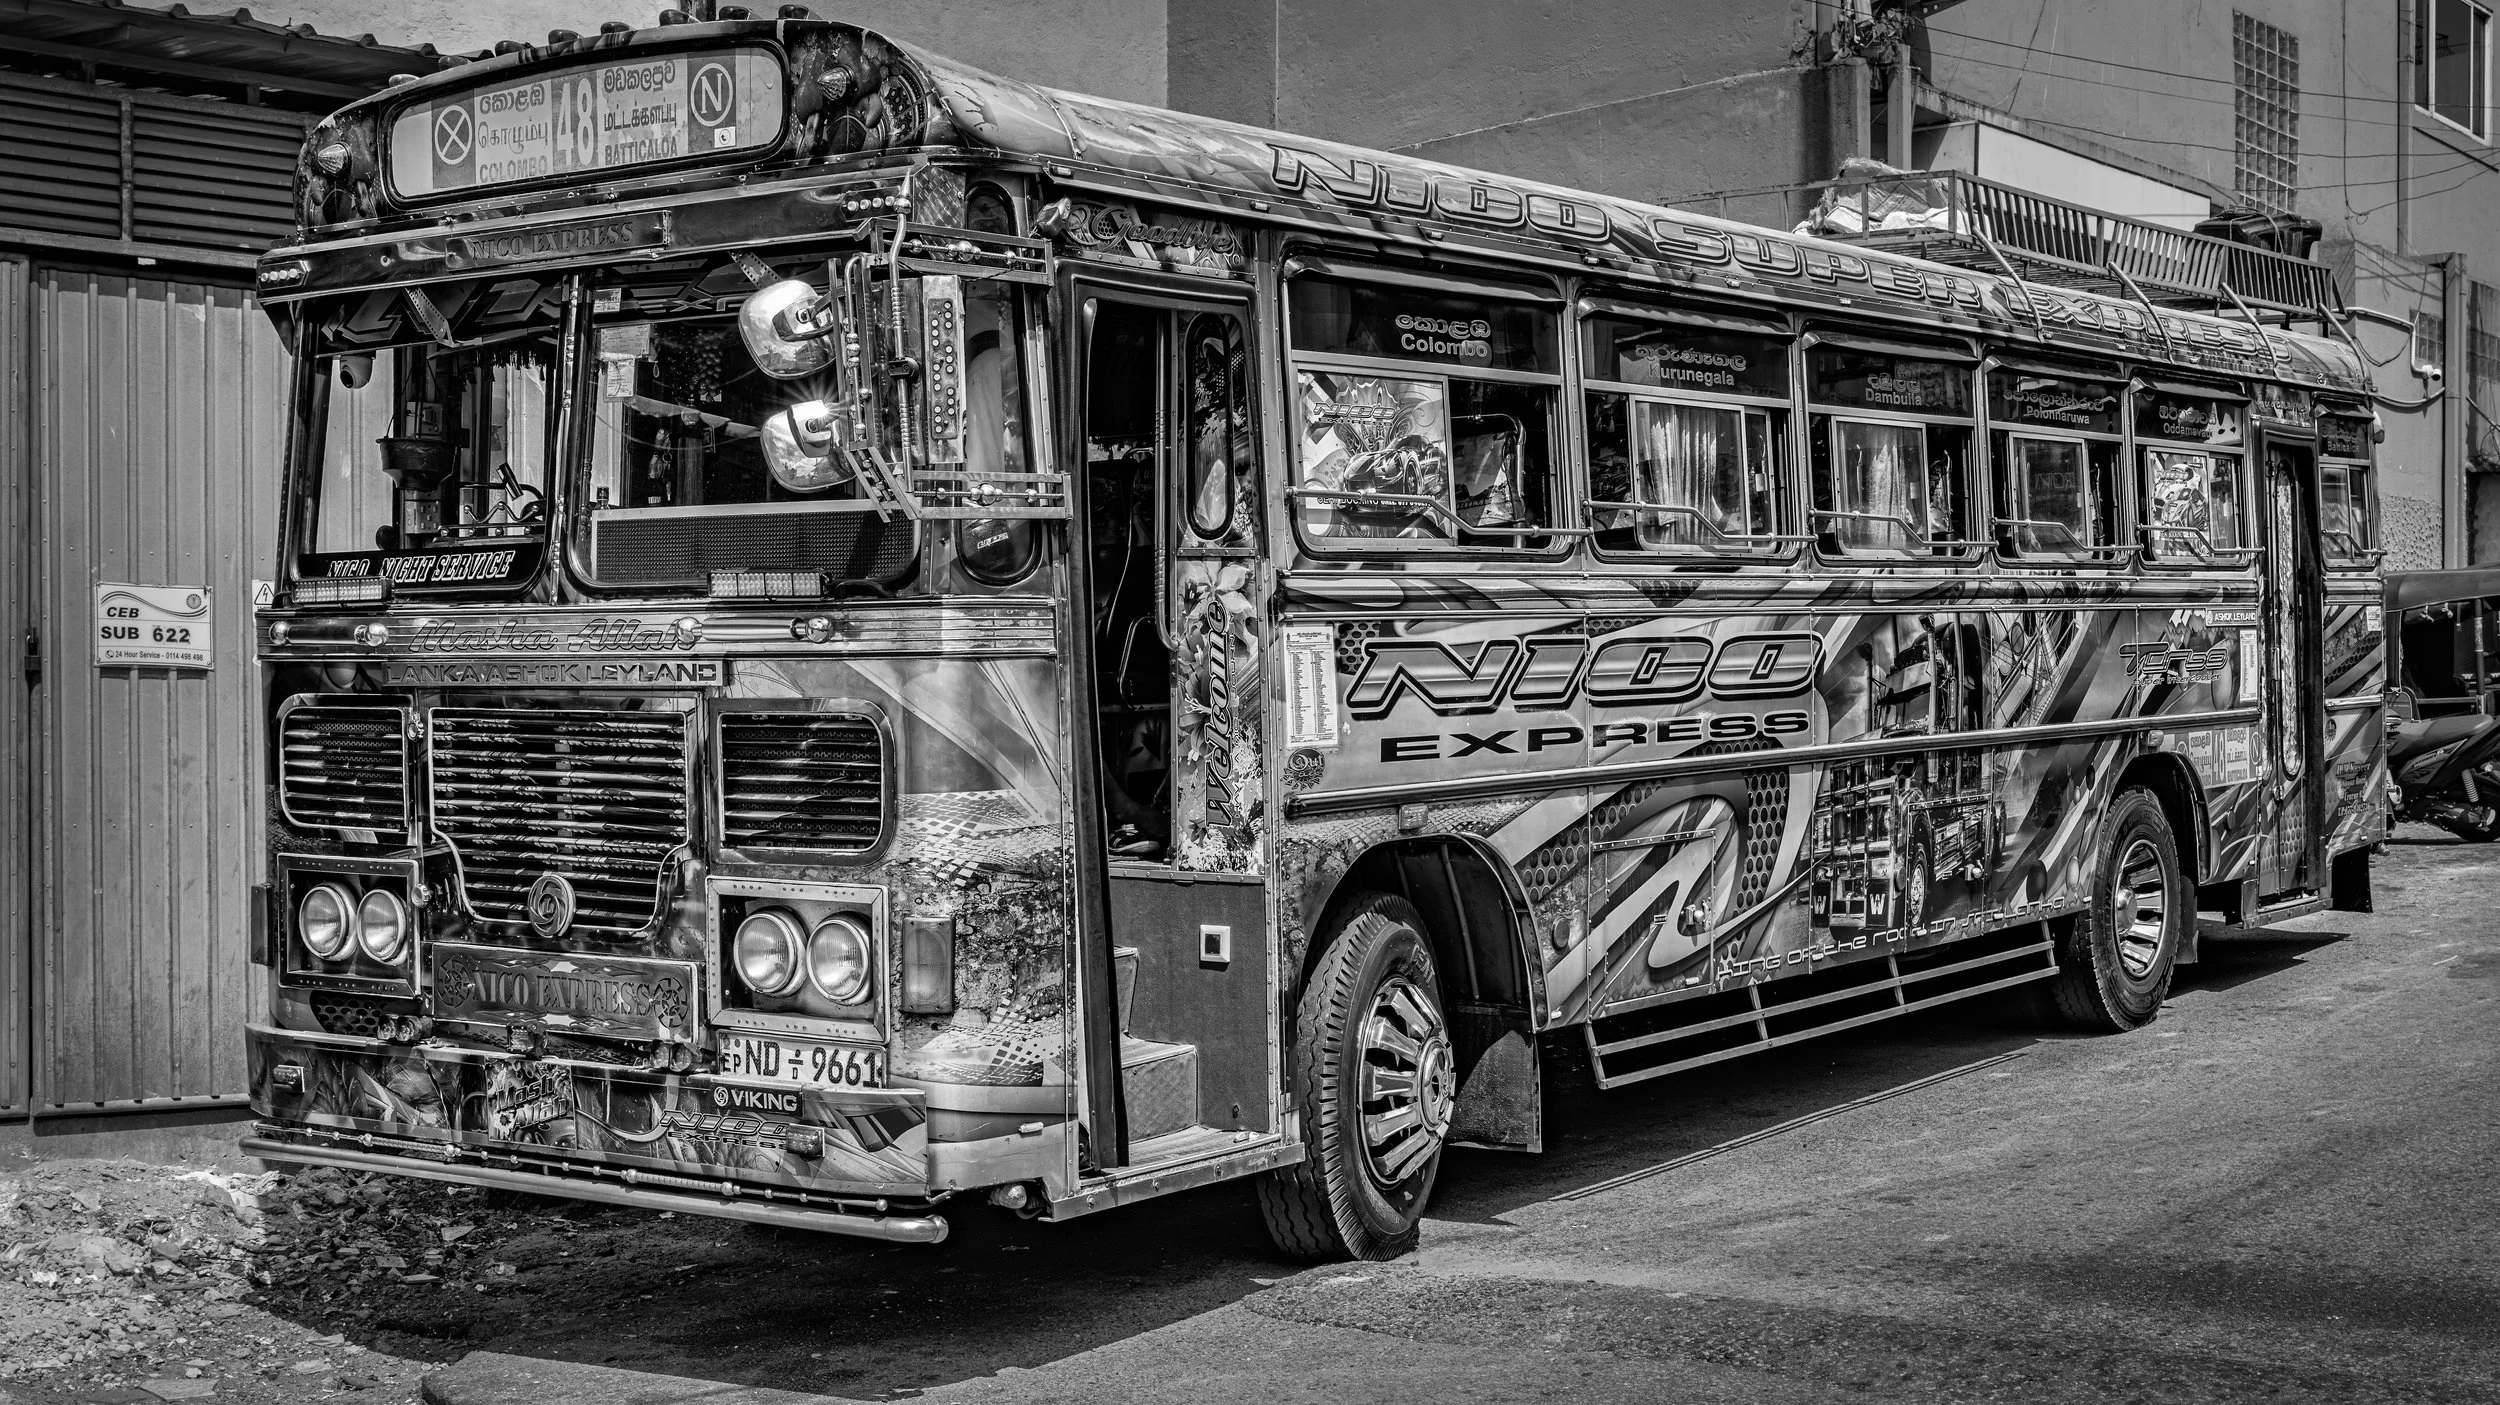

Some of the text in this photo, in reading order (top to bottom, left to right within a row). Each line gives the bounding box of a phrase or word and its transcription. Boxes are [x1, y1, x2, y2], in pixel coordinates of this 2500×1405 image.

[479, 82, 545, 115] කොළඹ
[700, 73, 723, 114] N
[556, 77, 595, 167] 48
[603, 96, 677, 132] மட்டக்களப்பு
[477, 115, 549, 154] கொழும்பு
[604, 136, 678, 167] BATTICALOA
[479, 155, 549, 183] COLOMBO
[472, 222, 633, 260] NICO EXPRESS
[1088, 205, 1237, 266] Goodbye
[1264, 141, 2295, 364] NICO SUPER EXPRESS
[1395, 314, 1491, 339] කොළඹ
[1401, 333, 1488, 358] Colombo
[1648, 361, 1735, 387] Kurunegala
[1313, 402, 1397, 420] NICO
[1865, 388, 1922, 406] Dambulla
[2026, 405, 2090, 424] Polonnaruwa
[327, 550, 516, 583] NICO NIGHT SERVICE
[106, 606, 140, 619] CEB
[2215, 612, 2256, 622] ASHOK LEYLAND
[101, 626, 191, 643] SUB 622
[408, 619, 559, 653] Masha
[124, 650, 138, 658] Hour
[139, 651, 161, 659] Service
[165, 652, 179, 660] 0114
[386, 663, 718, 684] LANKA ASHOK LEYLAND
[1345, 633, 1827, 720] NICO
[1204, 600, 1234, 828] Welcome
[1380, 711, 1810, 763] EXPRESS
[2213, 732, 2225, 781] 48
[1869, 893, 1886, 915] W
[472, 968, 652, 1016] NICO EXPRESS
[722, 1051, 742, 1073] EP
[730, 1089, 798, 1112] VIKING
[660, 1109, 789, 1137] NICO
